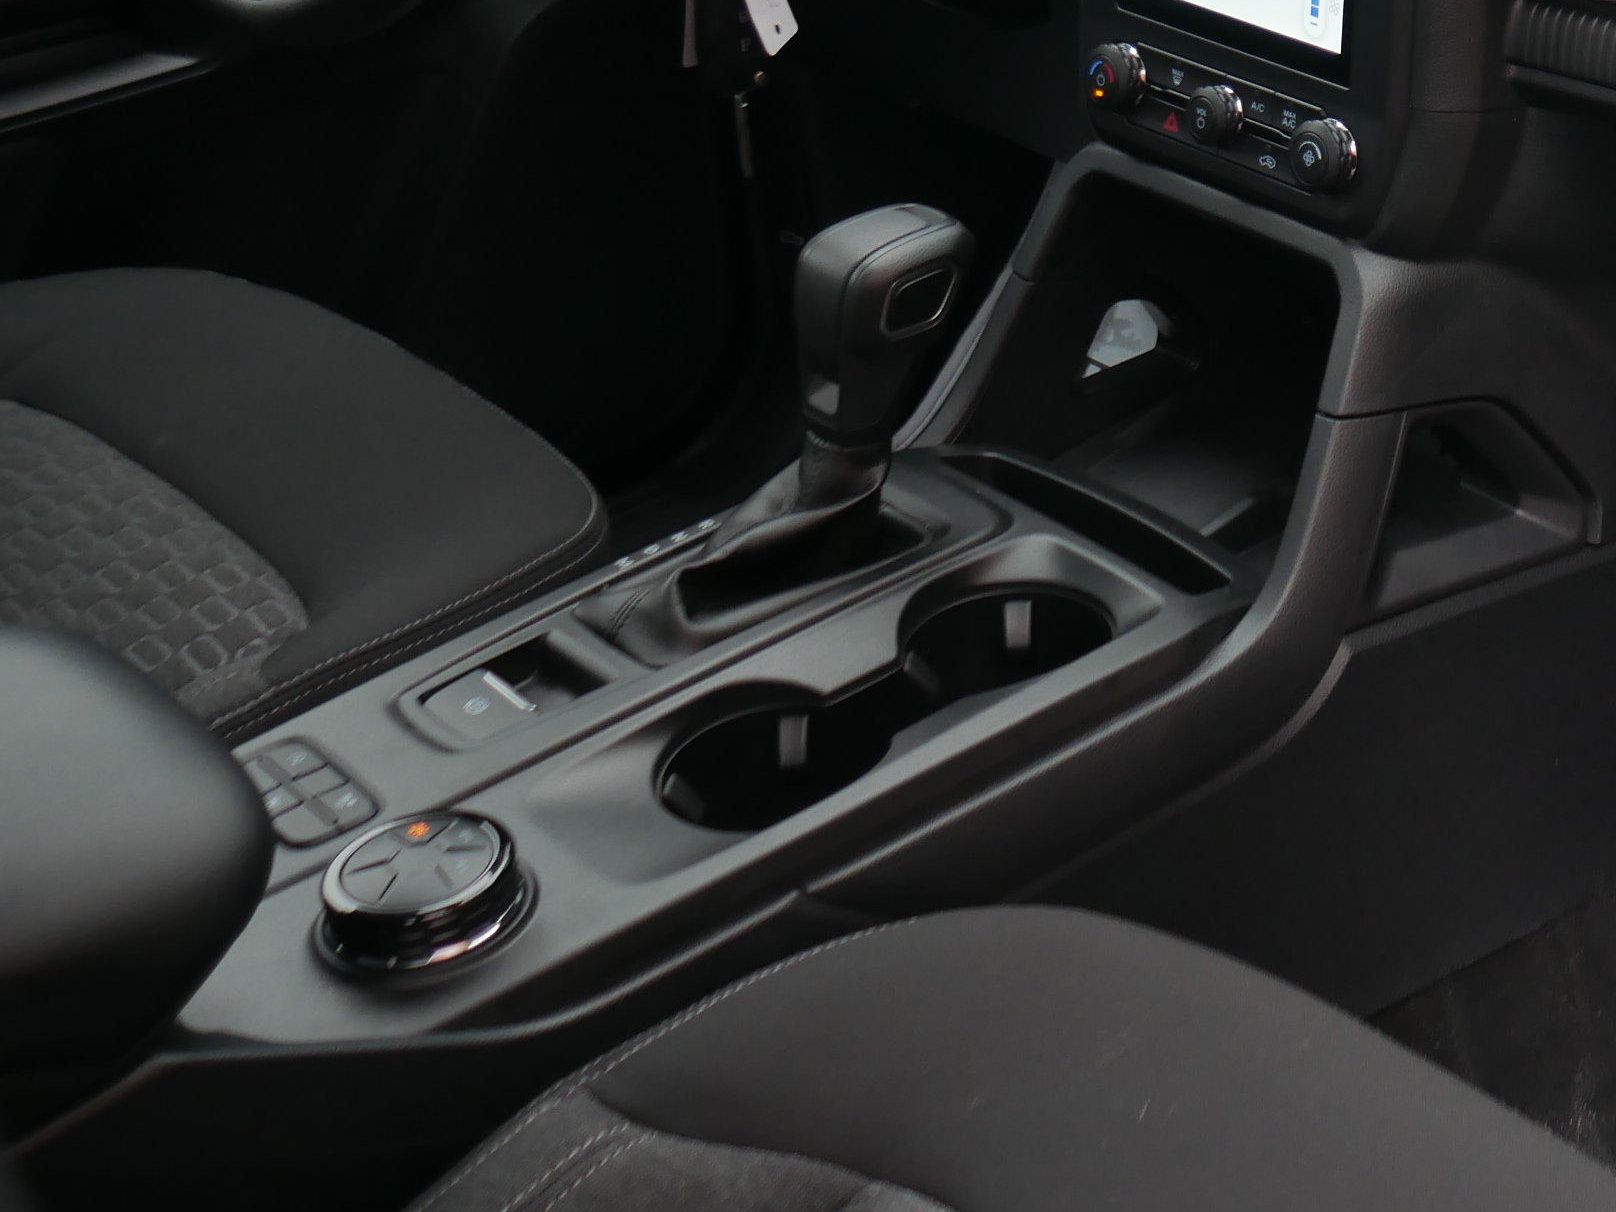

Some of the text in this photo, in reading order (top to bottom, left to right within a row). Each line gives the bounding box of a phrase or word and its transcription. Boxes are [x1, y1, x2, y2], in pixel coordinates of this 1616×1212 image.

[1171, 67, 1185, 78] MAX
[1251, 101, 1265, 114] A/C
[1283, 109, 1298, 120] MAX
[1281, 118, 1297, 130] A/C
